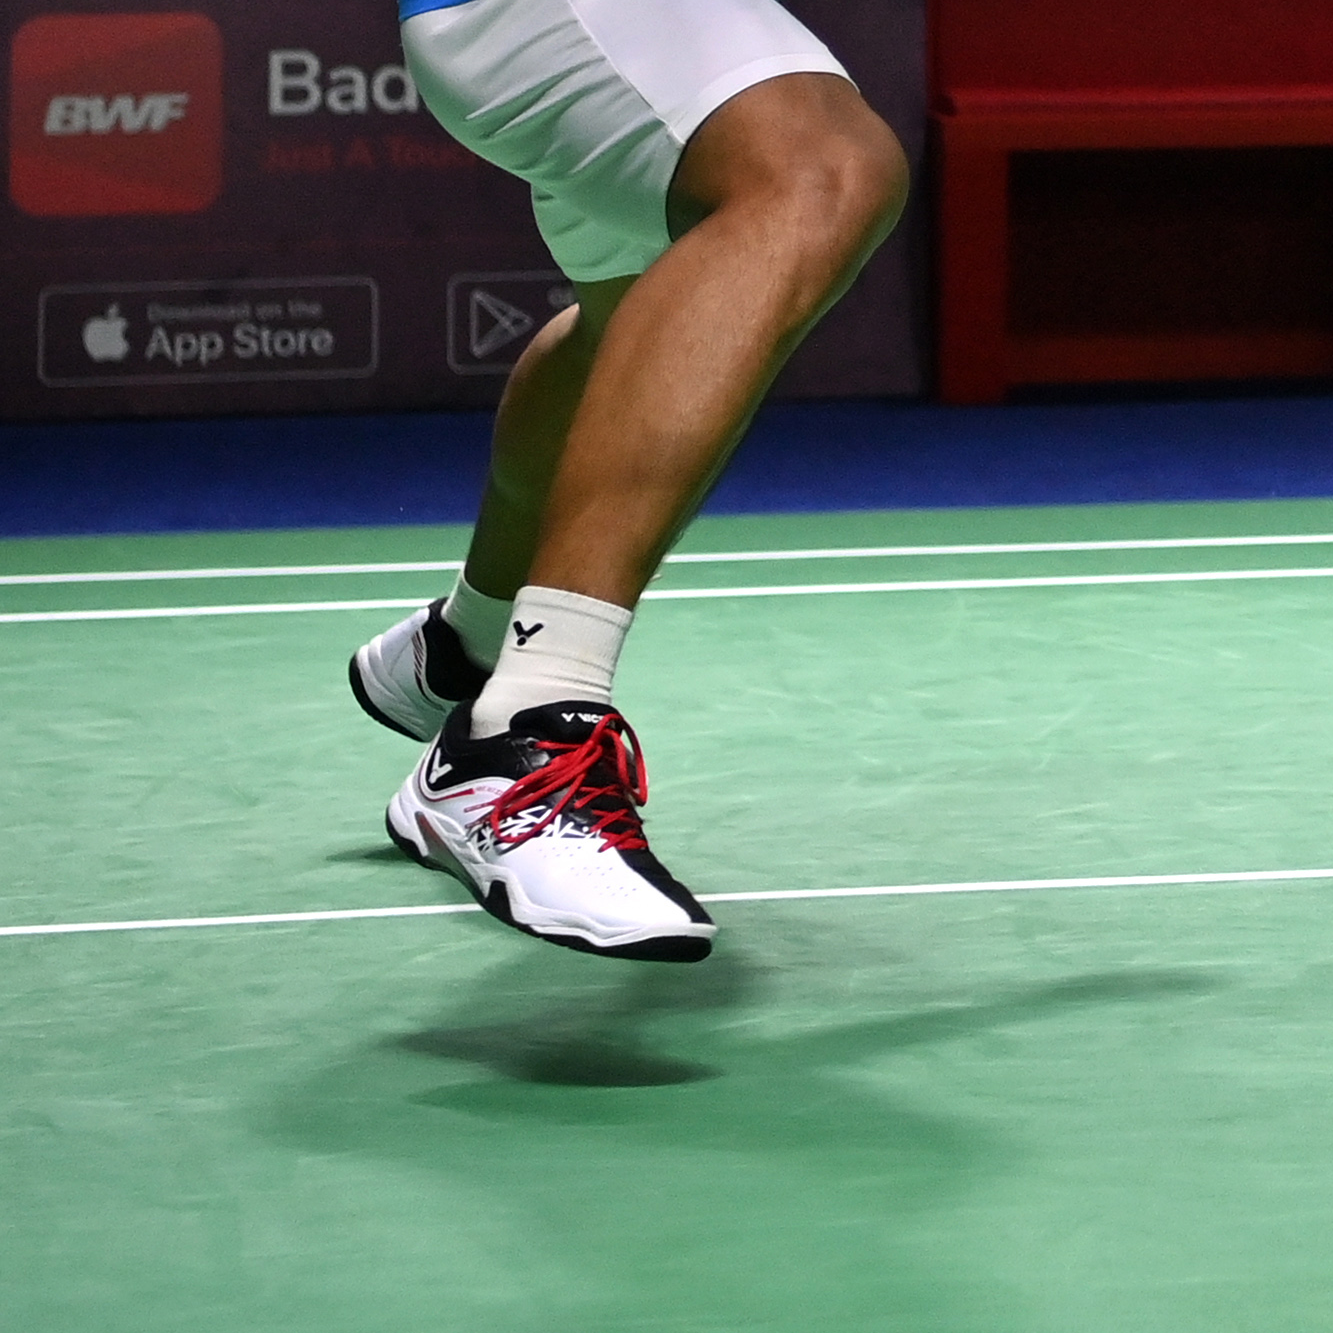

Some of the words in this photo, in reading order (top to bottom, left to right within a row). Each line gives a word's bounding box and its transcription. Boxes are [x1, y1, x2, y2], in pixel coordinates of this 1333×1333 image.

[44, 93, 190, 136] BWF
[145, 325, 224, 367] App
[233, 321, 334, 359] Store
